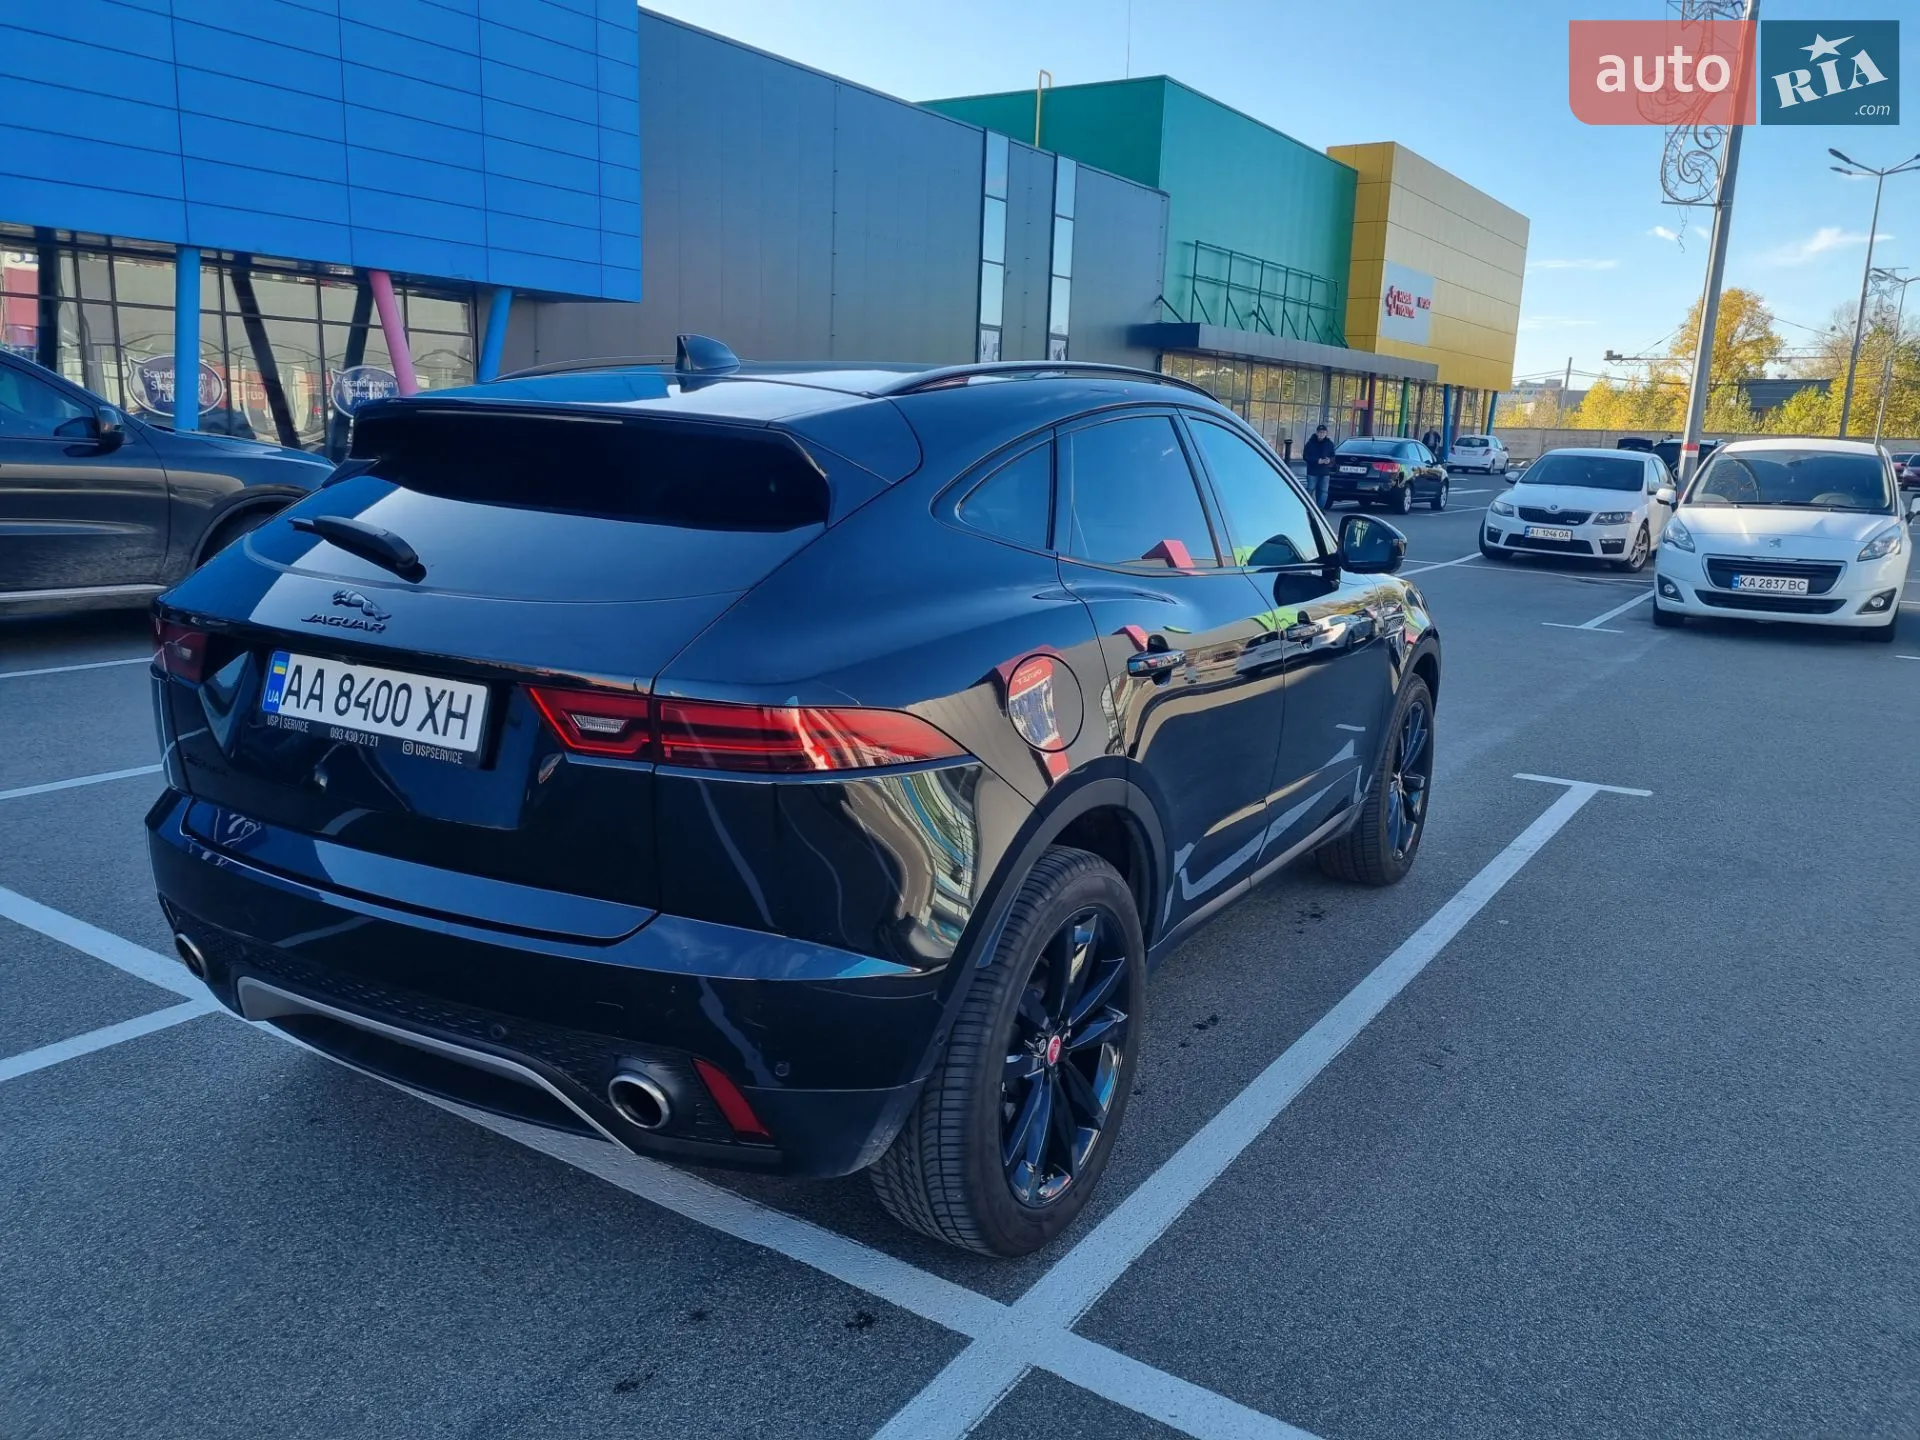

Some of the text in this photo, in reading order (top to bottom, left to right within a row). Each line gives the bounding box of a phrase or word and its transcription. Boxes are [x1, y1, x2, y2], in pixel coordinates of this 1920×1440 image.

[343, 378, 394, 389] Scandiavian
[1739, 577, 1806, 591] KA 2837 BC
[300, 613, 387, 634] JAGUAR
[267, 689, 280, 704] UA
[281, 664, 473, 741] AA 8400 XH
[267, 714, 309, 733] USP SERVICE
[330, 726, 344, 740] 093
[415, 743, 463, 765] USPSERVICE
